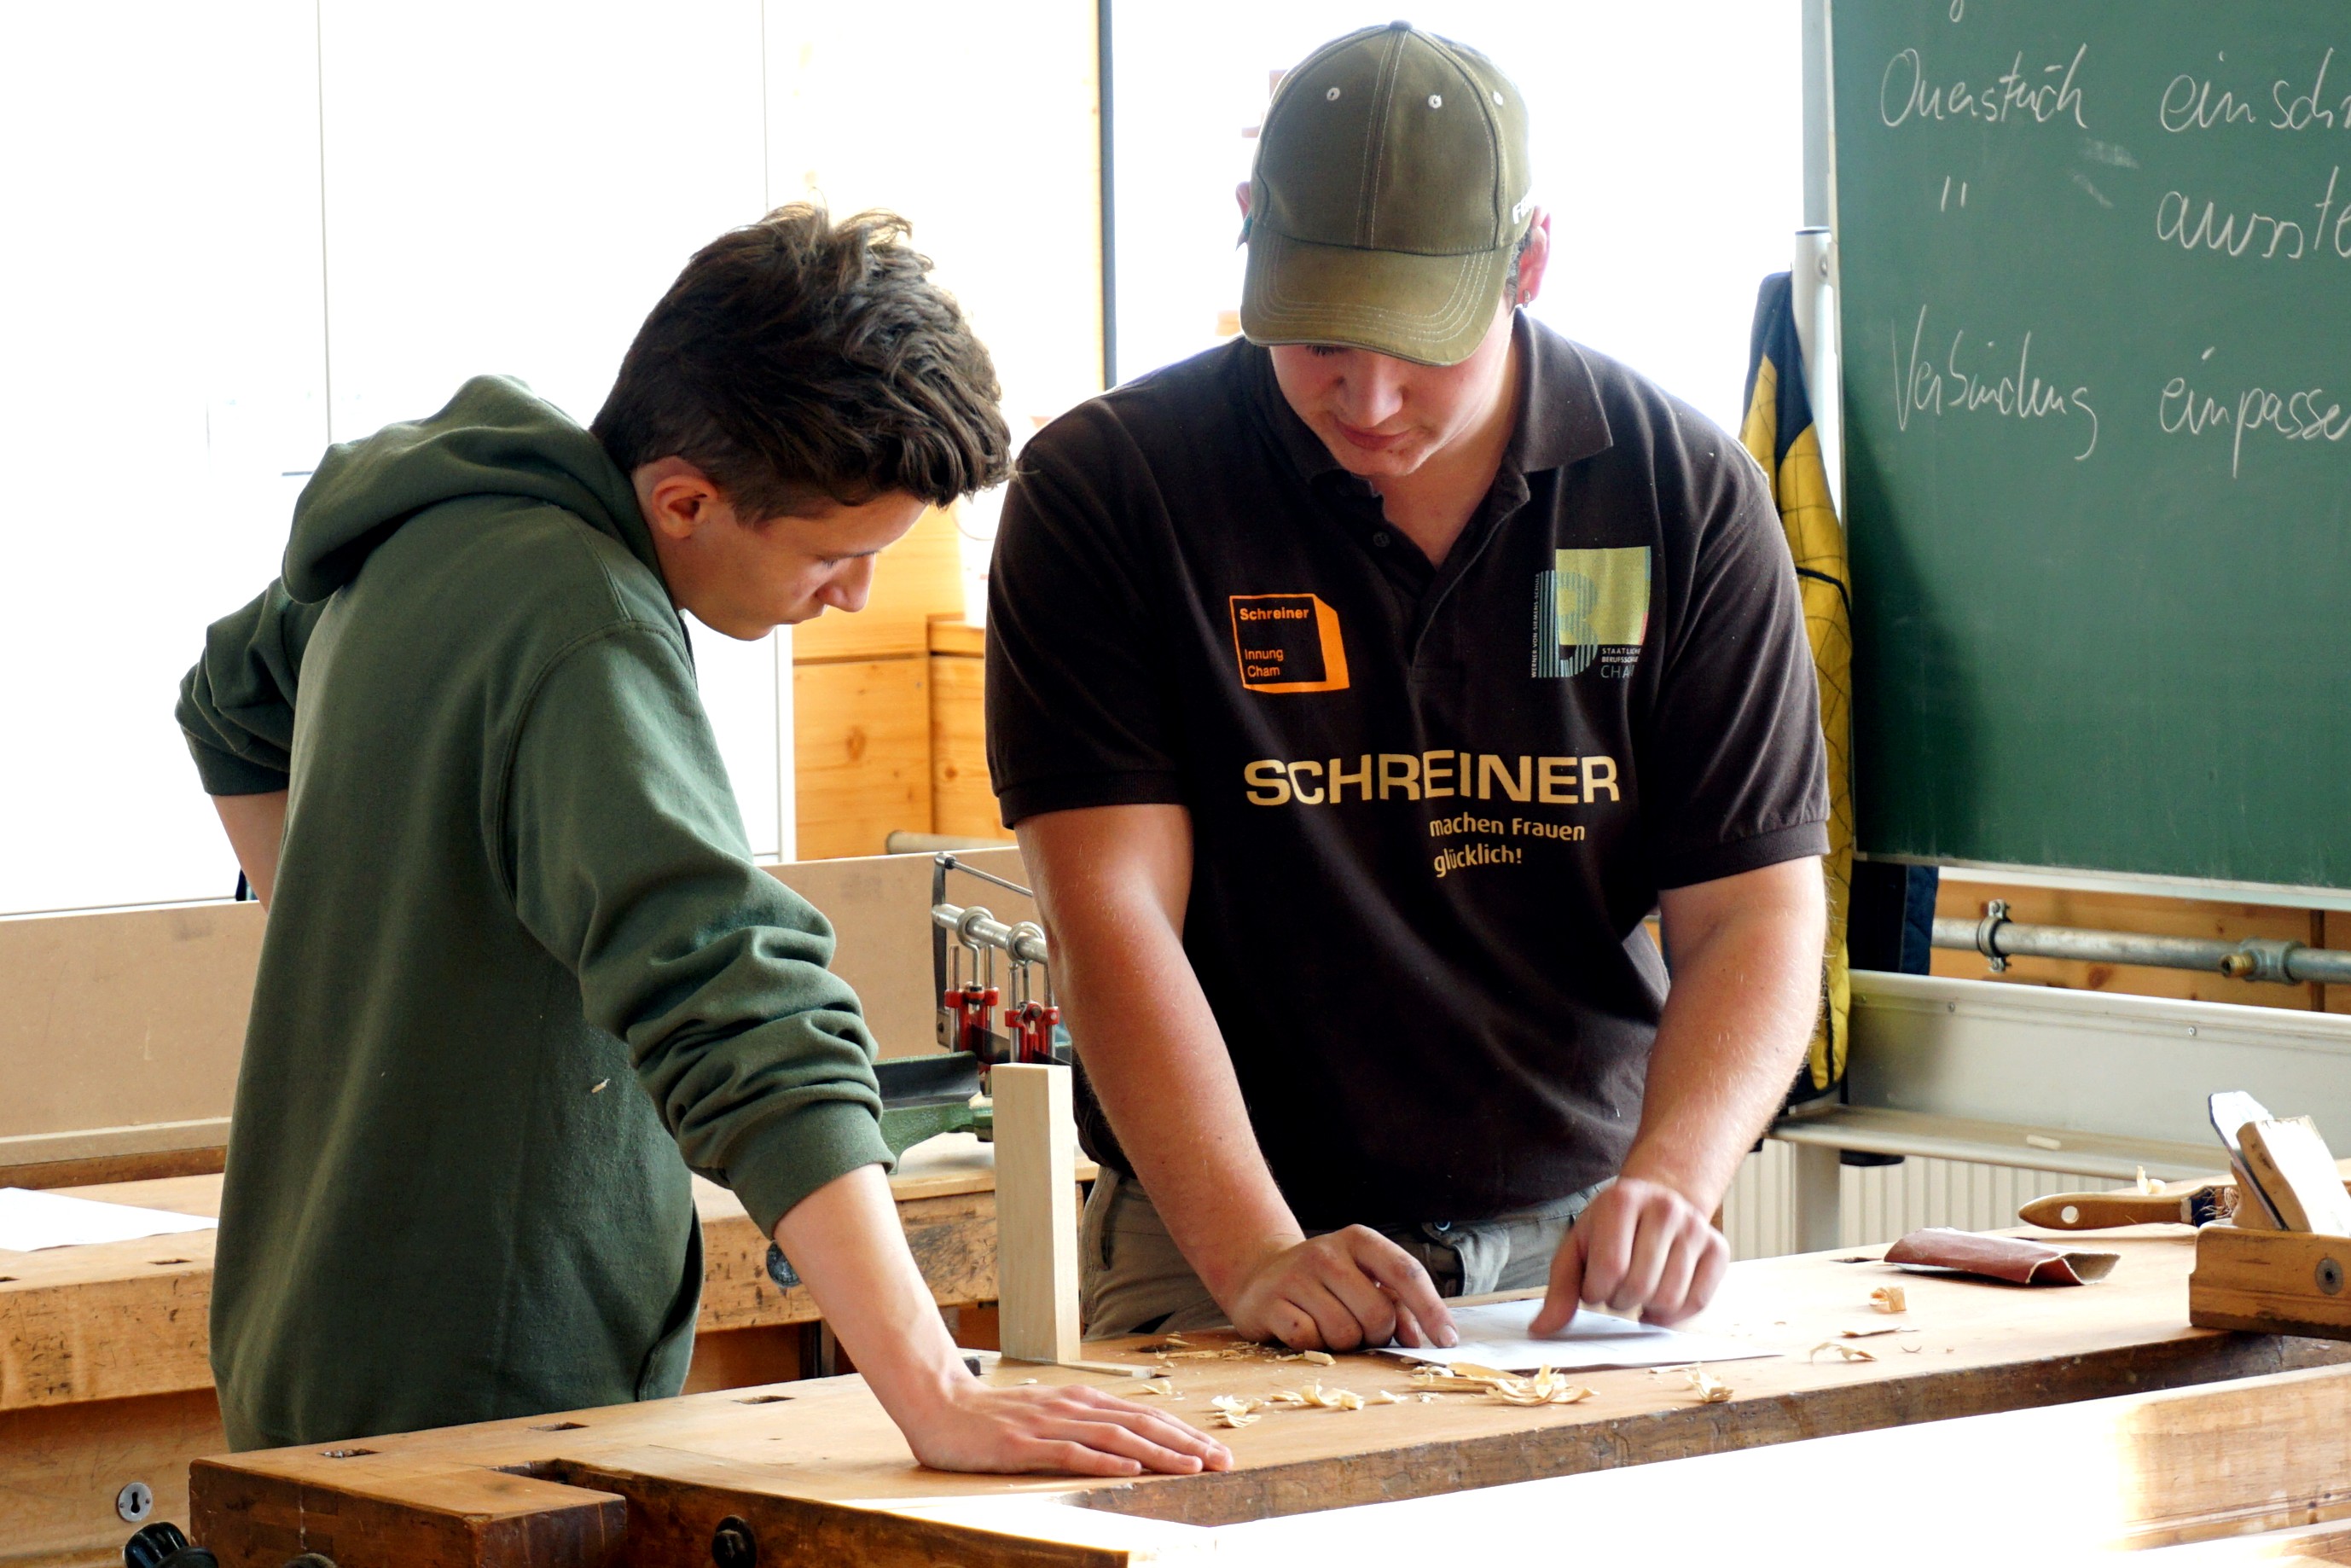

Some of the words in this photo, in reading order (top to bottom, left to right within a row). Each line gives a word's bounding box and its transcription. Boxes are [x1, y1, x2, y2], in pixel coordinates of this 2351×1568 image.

[1239, 607, 1309, 620] Schreiner
[1245, 649, 1284, 661] Innung
[1247, 665, 1280, 677] Cham
[1244, 749, 1620, 805] SCHREINER
[1430, 811, 1504, 838] machen
[1512, 817, 1585, 841] Frauen
[1433, 842, 1522, 878] glücklich!
